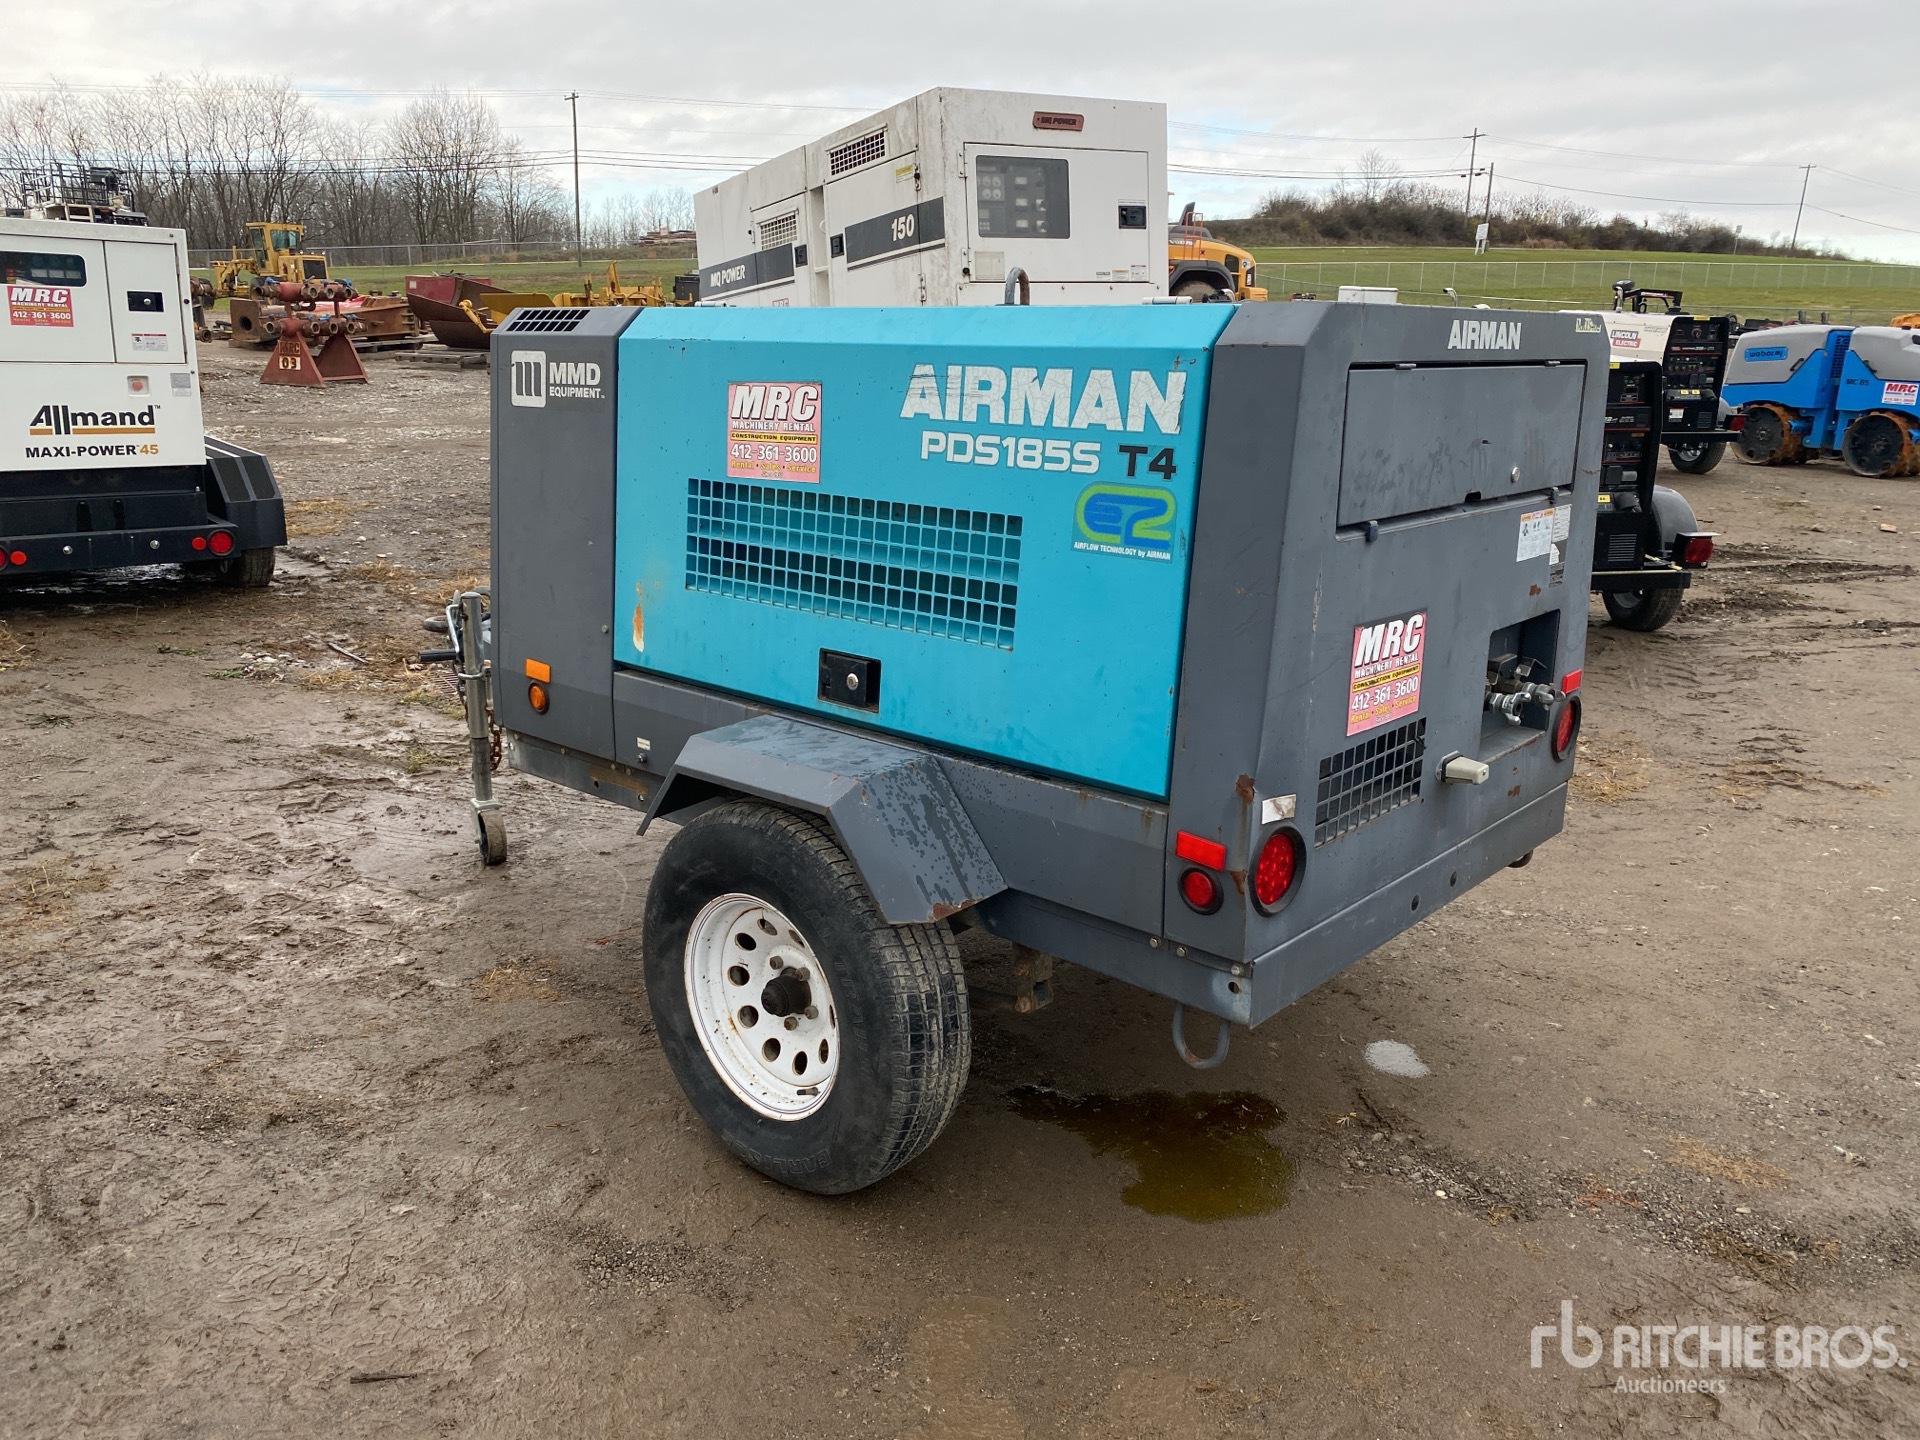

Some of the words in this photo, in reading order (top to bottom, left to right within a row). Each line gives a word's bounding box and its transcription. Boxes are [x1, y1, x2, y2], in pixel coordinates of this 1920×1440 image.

[892, 214, 914, 241] 150
[711, 271, 721, 287] MQ
[722, 265, 746, 285] POWER
[11, 288, 68, 304] MRC
[13, 311, 71, 320] 412-361-3600
[1447, 319, 1522, 350] AIRMAN
[1611, 331, 1638, 340] LINCOLN
[281, 357, 297, 369] 03
[549, 362, 601, 386] MMD
[549, 386, 602, 398] EQUIPMENT
[1886, 383, 1918, 393] MRC
[731, 385, 819, 422] MRC
[900, 363, 1187, 434] AIRMAN
[30, 405, 155, 435] Allmand
[732, 420, 780, 432] MACHINERY
[783, 422, 815, 432] RENTAL
[780, 434, 816, 442] EQUIPMENT
[25, 445, 137, 458] MAXI-POWER
[140, 444, 159, 455] 45
[731, 443, 817, 463] 412-361-3600
[921, 430, 1101, 474] PDS185S
[1119, 445, 1177, 480] T4
[731, 459, 755, 470] Rental
[760, 461, 781, 471] Sales
[786, 463, 816, 473] Service
[1073, 542, 1102, 552] AIRFLOW
[1100, 545, 1136, 556] TECHNOLOGY
[1138, 549, 1146, 558] by
[1147, 550, 1171, 560] AIRMAN
[1354, 613, 1423, 668] MRC
[1354, 661, 1392, 679] MACHINERY
[1395, 654, 1419, 667] RENTAL
[1393, 666, 1419, 679] EQUIPMENT
[1352, 676, 1419, 712] 412-361-3600
